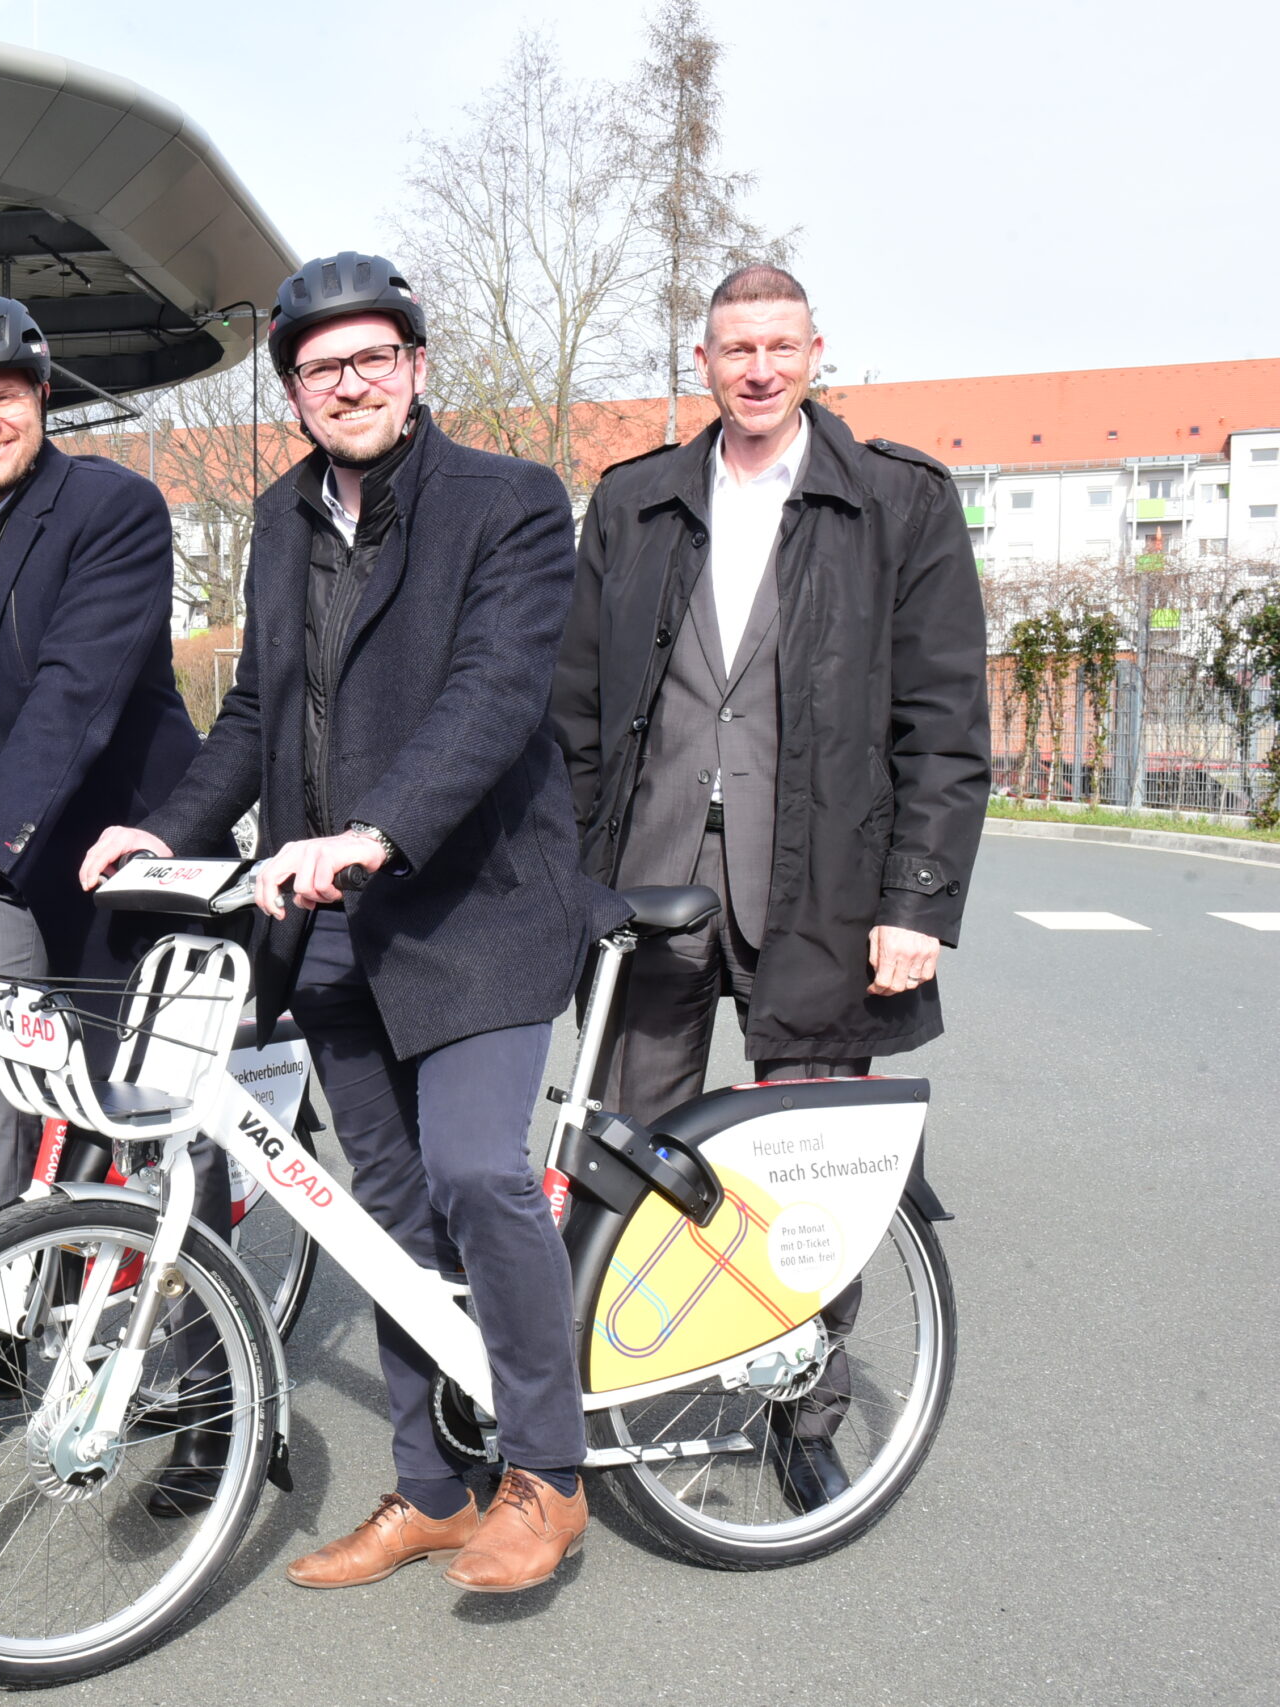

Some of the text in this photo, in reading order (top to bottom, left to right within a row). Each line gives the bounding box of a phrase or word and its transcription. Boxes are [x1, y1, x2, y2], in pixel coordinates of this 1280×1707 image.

[143, 866, 203, 880] VAG RAD
[21, 1013, 55, 1042] RAD
[753, 1133, 824, 1157] Heute mal
[238, 1110, 333, 1207] VAG RAD
[769, 1154, 900, 1184] nach Schwabach?
[782, 1224, 825, 1236] Pro Monat
[781, 1238, 830, 1251] mit D-Ticket
[781, 1251, 836, 1267] 600 Min. frei!
